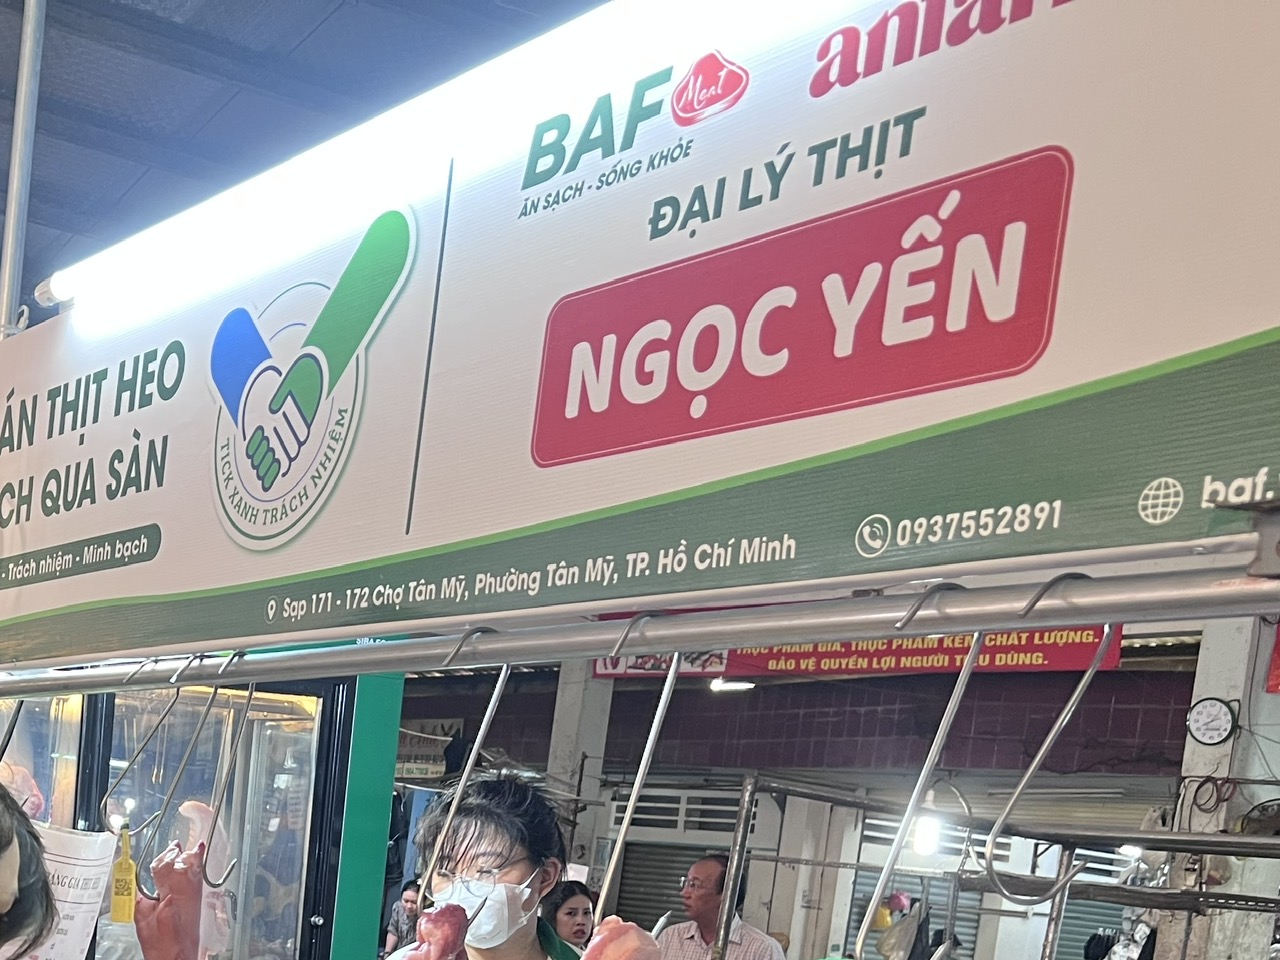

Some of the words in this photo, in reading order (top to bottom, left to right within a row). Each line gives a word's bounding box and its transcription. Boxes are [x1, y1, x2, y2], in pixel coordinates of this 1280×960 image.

[521, 65, 674, 191] BAF
[678, 67, 729, 109] Meat
[517, 196, 540, 219] ĂN
[542, 181, 585, 211] SẠCH
[596, 159, 642, 191] SỐNG
[646, 137, 694, 173] KHỎE
[648, 176, 726, 241] ĐẠI
[738, 141, 796, 211] LÝ
[807, 105, 927, 187] THỊT
[564, 285, 798, 419] NGỌC
[821, 189, 1027, 358] YẾN
[46, 367, 109, 446] THỊT
[114, 339, 186, 417] HEO
[41, 457, 97, 517] QUA
[106, 428, 169, 501] SÀN
[220, 437, 234, 490] TICK
[228, 486, 259, 525] XANH
[262, 485, 309, 526] TRÁCH
[310, 407, 348, 489] NHIỆM
[1201, 466, 1280, 509] baf.
[8, 559, 36, 581] Trách
[39, 554, 73, 576] nhiệm
[82, 544, 111, 565] Minh
[115, 535, 148, 562] bạch
[896, 500, 1062, 547] 0937552891
[282, 597, 307, 622] Sạp
[311, 592, 332, 614] 171
[346, 587, 369, 610] 172
[372, 584, 405, 611] Chợ
[408, 579, 435, 602] Tân
[440, 574, 469, 602] Mỹ,
[474, 567, 541, 596] Phường
[546, 560, 579, 587] Tân
[584, 555, 618, 586] Mỹ,
[626, 552, 650, 578] TP.
[657, 539, 687, 574] Hồ
[694, 538, 735, 571] Chí
[739, 533, 796, 565] Minh
[768, 656, 795, 671] BẢO
[799, 656, 816, 672] VỆ
[872, 656, 895, 671] LỢI
[900, 653, 949, 670] NGƯỜI
[995, 651, 1048, 666] DÙNG.
[1033, 629, 1100, 648] LƯỢNG.
